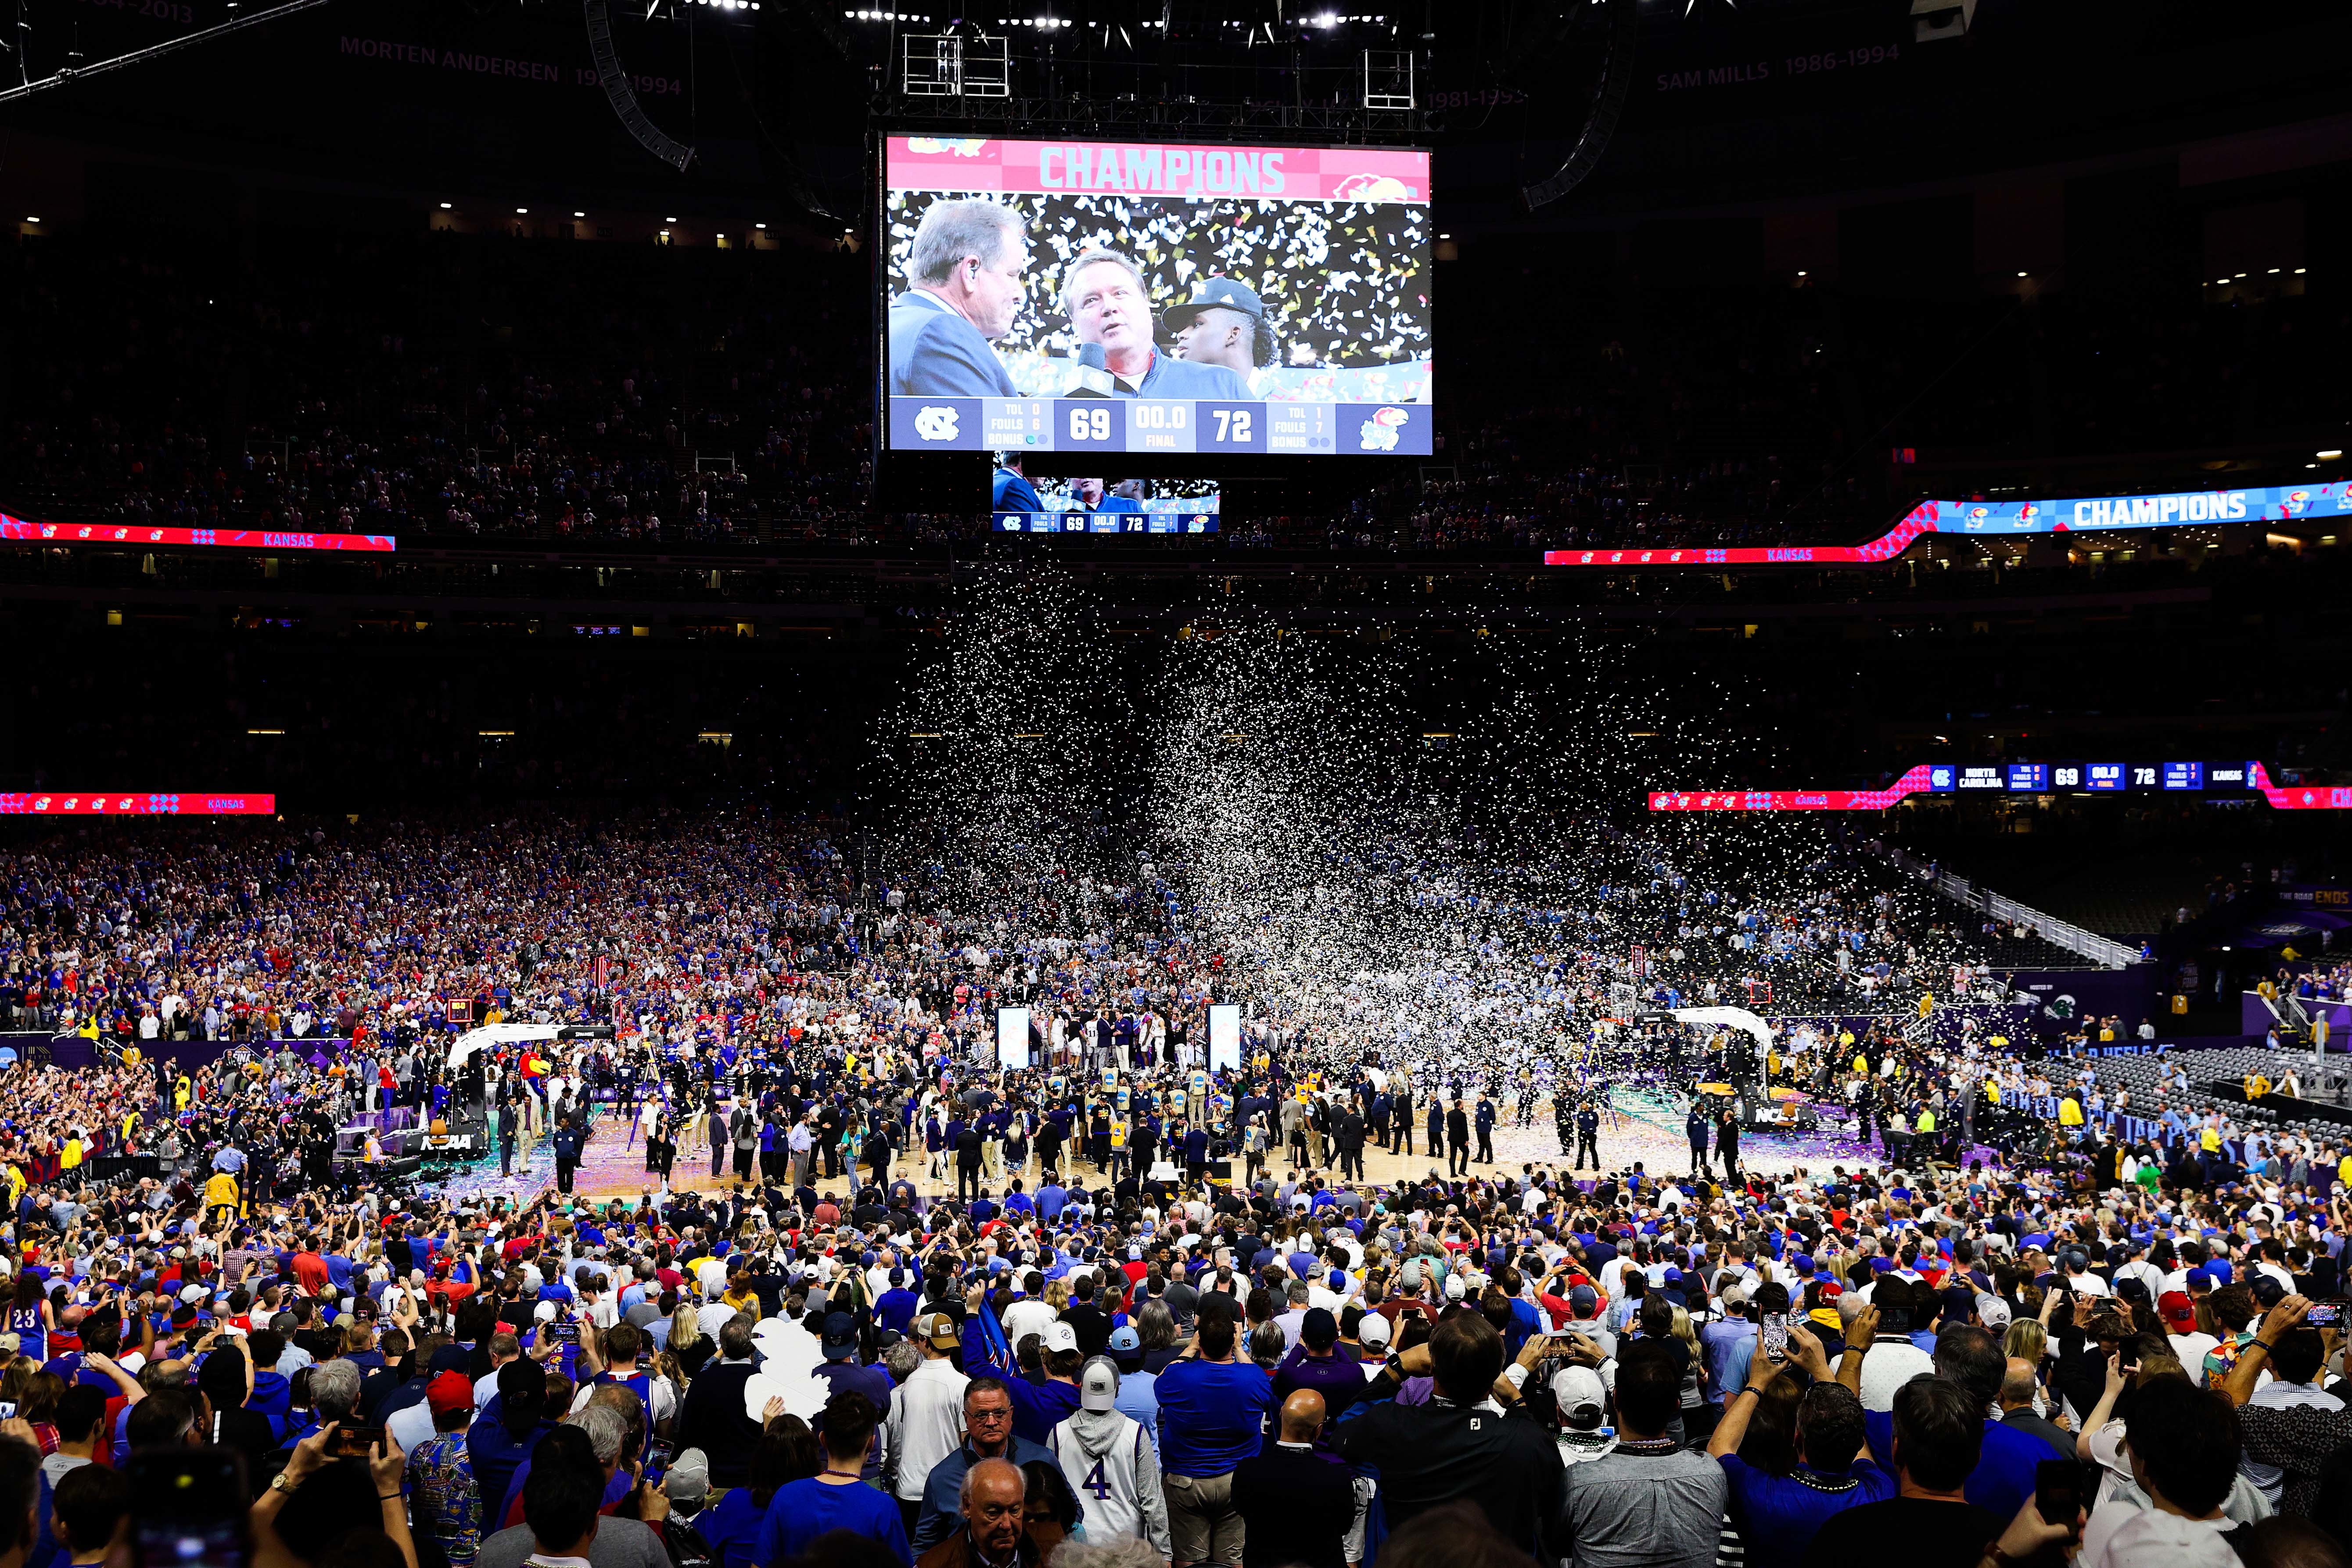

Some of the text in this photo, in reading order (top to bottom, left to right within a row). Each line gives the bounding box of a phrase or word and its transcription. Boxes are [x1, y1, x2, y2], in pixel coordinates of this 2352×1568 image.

[340, 35, 682, 96] MORTEN ANDERSEN 19-1994
[1657, 42, 1900, 91] SAM MILLS 1986-1994
[1039, 147, 1286, 194] CHAMPIONS
[1005, 403, 1040, 415] TOL 0
[1288, 407, 1321, 419] TOL 1
[991, 418, 1040, 430] FOULS 6
[1070, 408, 1110, 440] 69
[1135, 405, 1186, 429] 00.0
[1212, 410, 1252, 442] 72
[1275, 421, 1322, 434] FOULS 7
[988, 433, 1024, 445] BONUS
[1145, 435, 1176, 447] FINAL
[1271, 436, 1307, 448] BONUS
[2074, 492, 2247, 527] CHAMPIONS
[1066, 517, 1084, 531] 69
[1094, 515, 1115, 526] 00.0
[1126, 517, 1143, 531] 72
[264, 532, 314, 548] KANSAS
[1767, 548, 1813, 561] KANSAS
[1965, 768, 1996, 778] NORTH
[2055, 768, 2079, 786] 69
[2092, 766, 2119, 779] 00.0
[2134, 768, 2155, 785] 72
[2212, 770, 2243, 781] KANSAS
[1959, 778, 2004, 788] CAROLINA
[208, 799, 244, 809] KANSAS
[2315, 890, 2349, 904] ENDS
[420, 1134, 471, 1151] NAA
[14, 1308, 36, 1329] 23
[1470, 1418, 1481, 1430] FJ
[1082, 1457, 1112, 1500] 4
